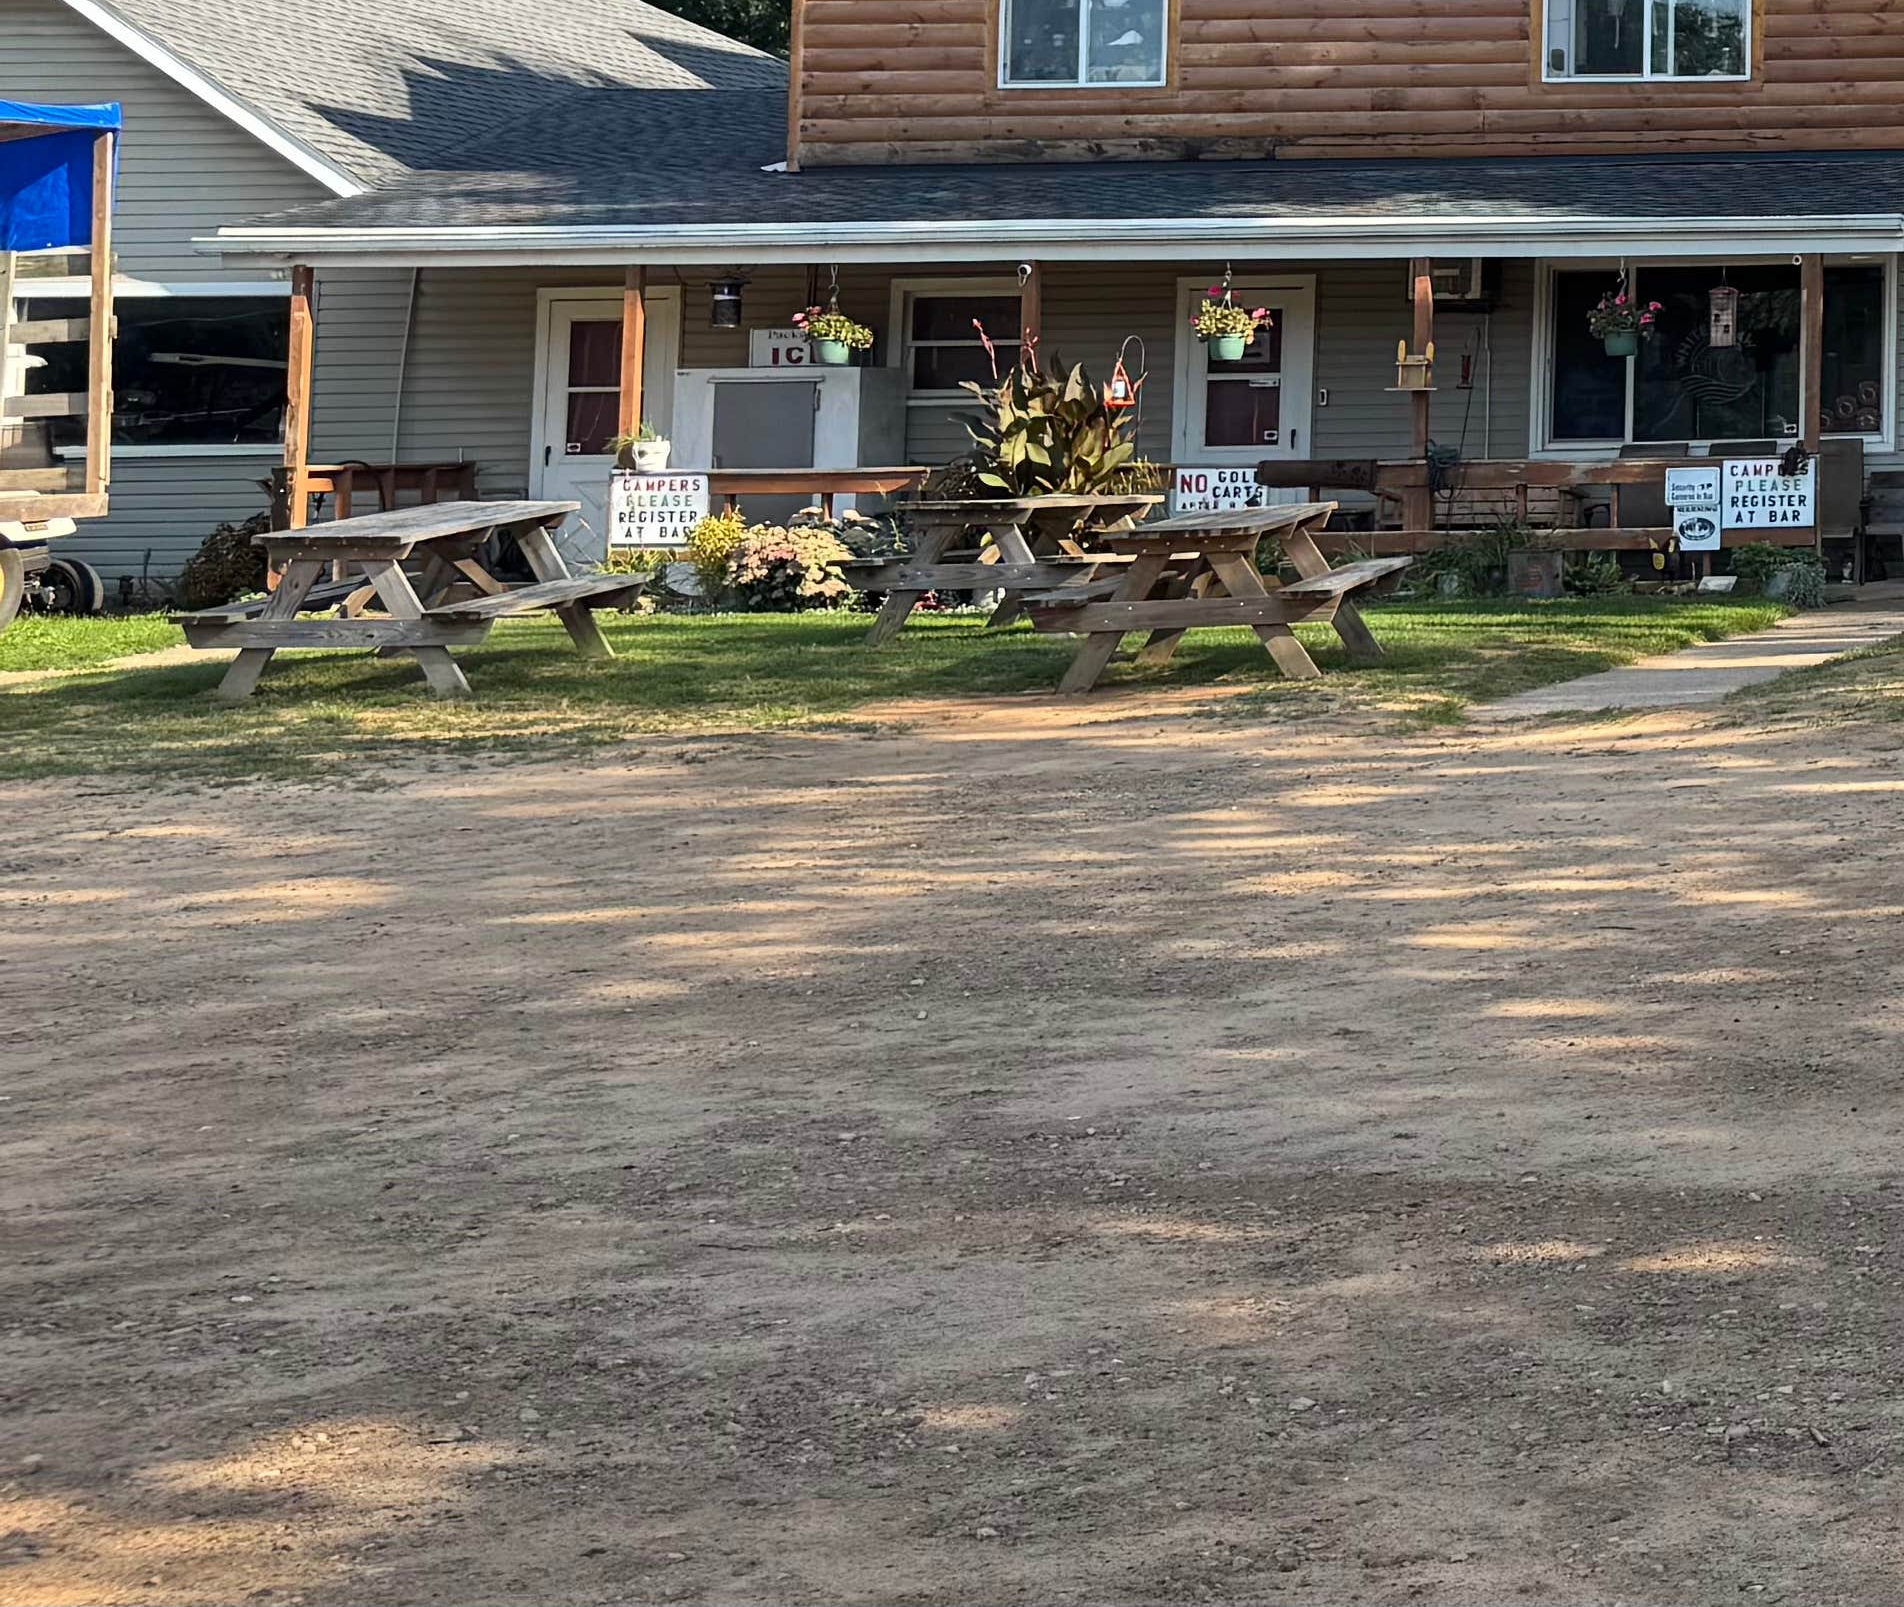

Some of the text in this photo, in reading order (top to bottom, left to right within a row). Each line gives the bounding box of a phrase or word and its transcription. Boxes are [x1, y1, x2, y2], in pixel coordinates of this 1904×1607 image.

[623, 479, 700, 491] CAMPERS
[1181, 474, 1207, 493] NO
[1735, 479, 1802, 492] PLEASE
[627, 494, 692, 507] PLEASE
[1731, 495, 1807, 507] REGISTER
[619, 511, 697, 523] REGISTER
[1735, 510, 1801, 523] AT BAR
[625, 527, 644, 537] AT
